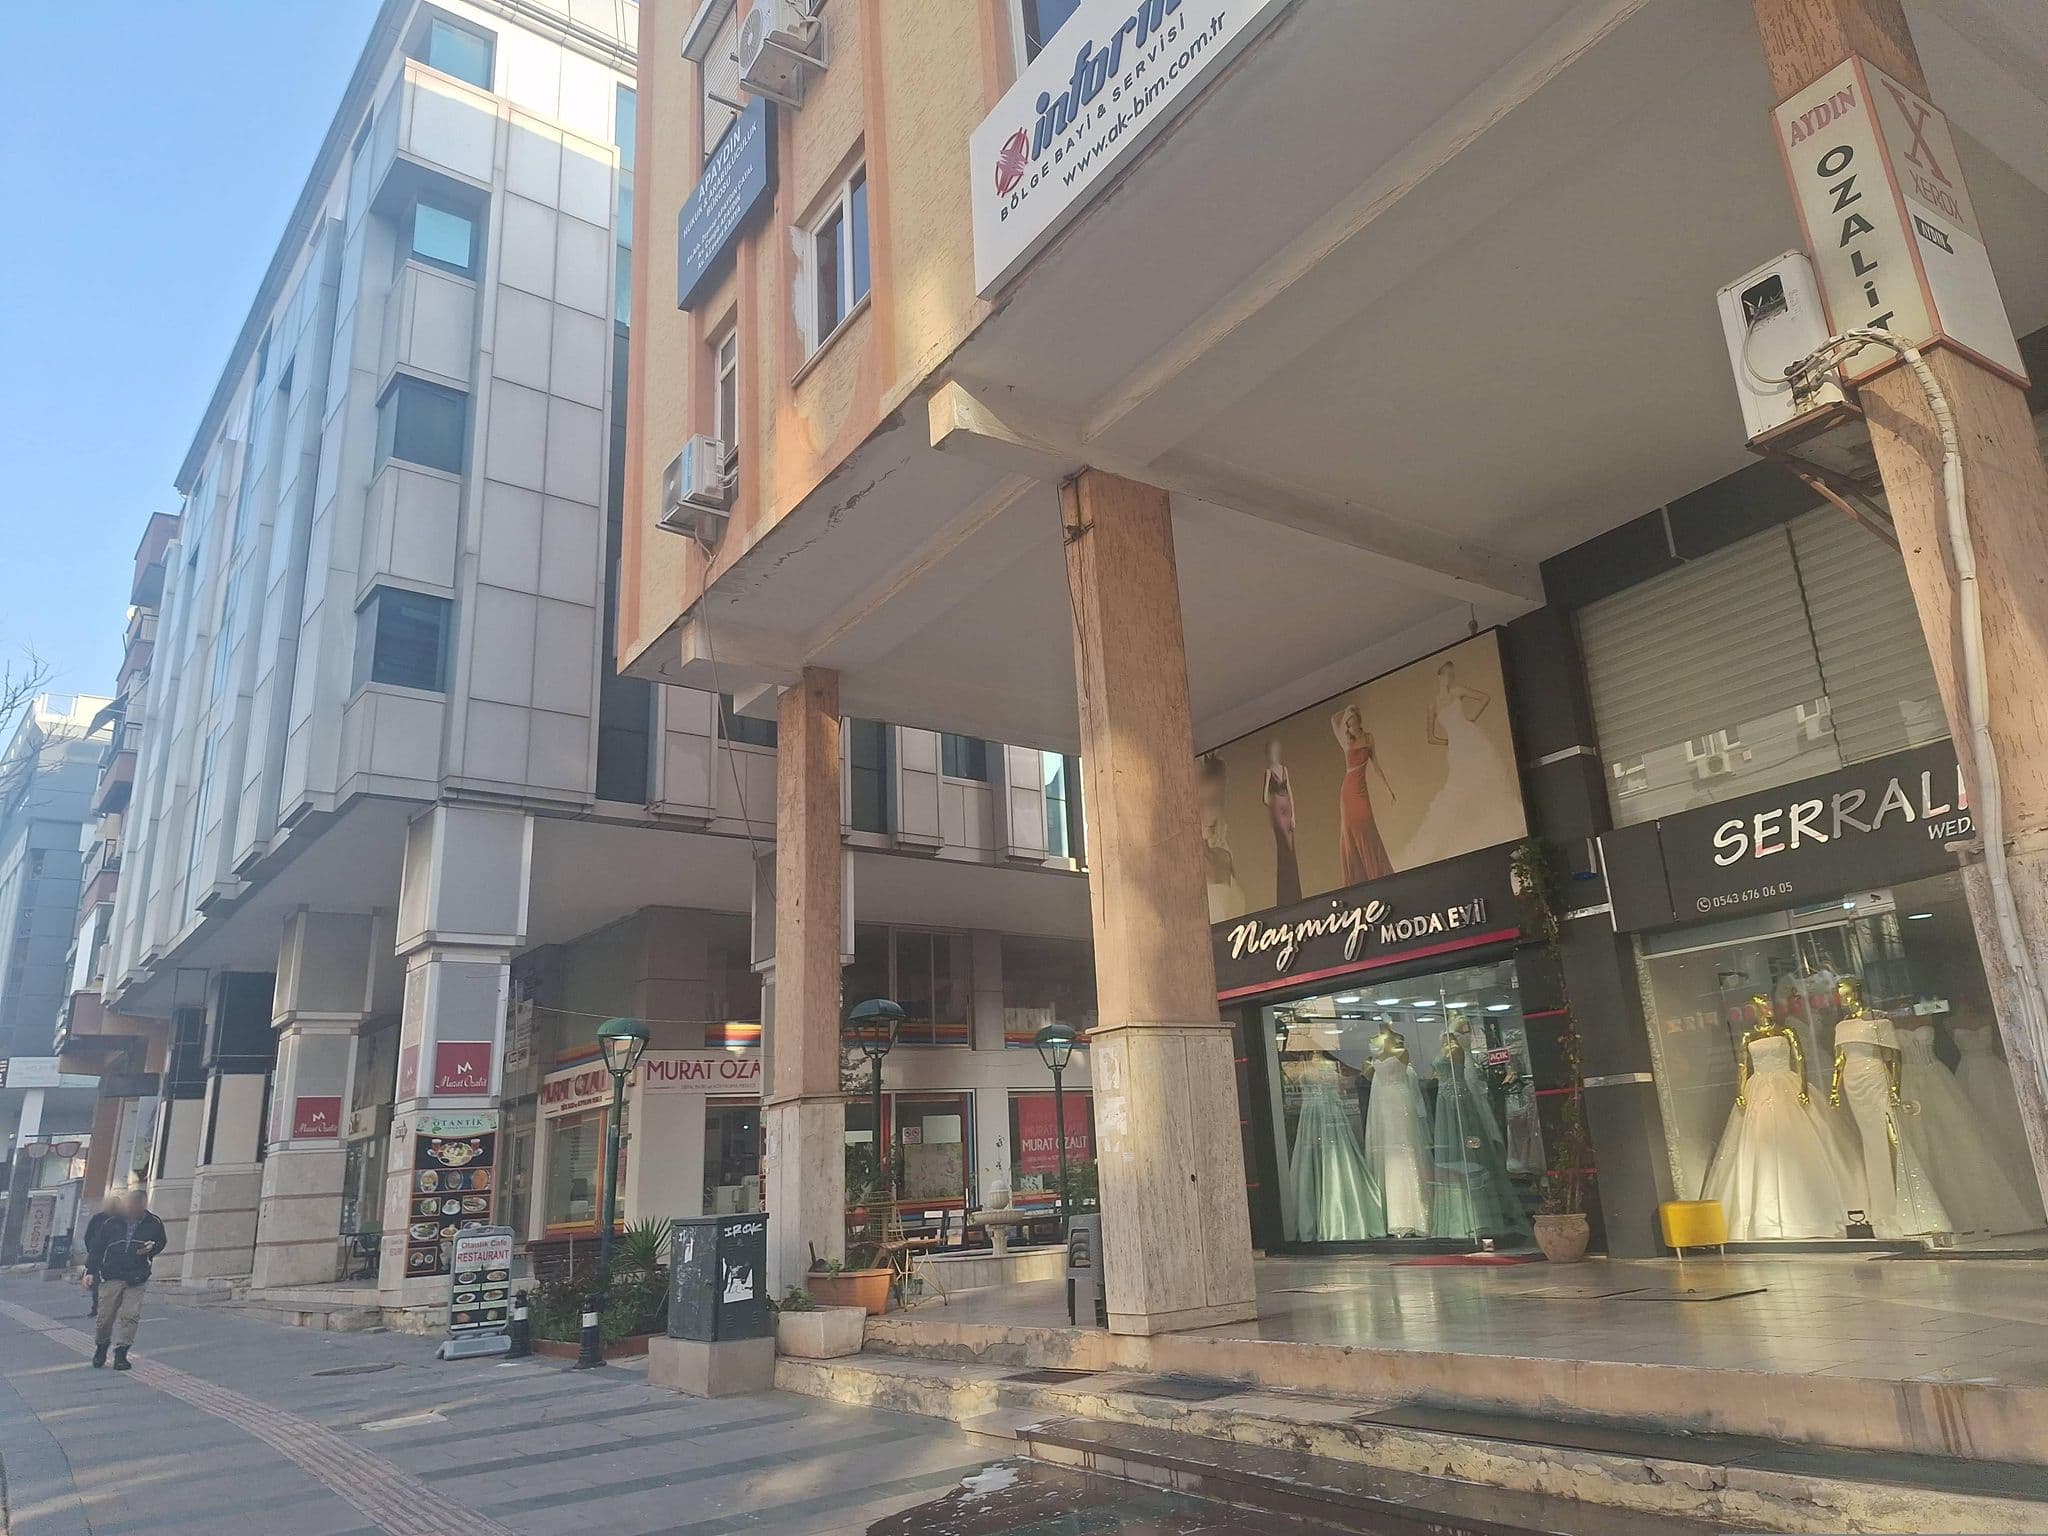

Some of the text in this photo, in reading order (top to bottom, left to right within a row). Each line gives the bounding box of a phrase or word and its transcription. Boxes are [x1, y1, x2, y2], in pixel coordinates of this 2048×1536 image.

[1062, 11, 1226, 187] www.ak-bim.com.tr
[1790, 84, 1857, 147] AYDIN
[1001, 12, 1185, 222] BÖLGE BAYİ & SERVİSİ
[698, 125, 741, 202] APAYDIN
[1907, 168, 1965, 225] XEROX
[1927, 816, 1976, 840] WED
[1712, 881, 1793, 908] 0543 676 06 05
[1380, 911, 1445, 945] MODA
[646, 1059, 716, 1081] MURAT
[1022, 1138, 1054, 1153] MURAT
[456, 1249, 510, 1263] RESTAURANT
